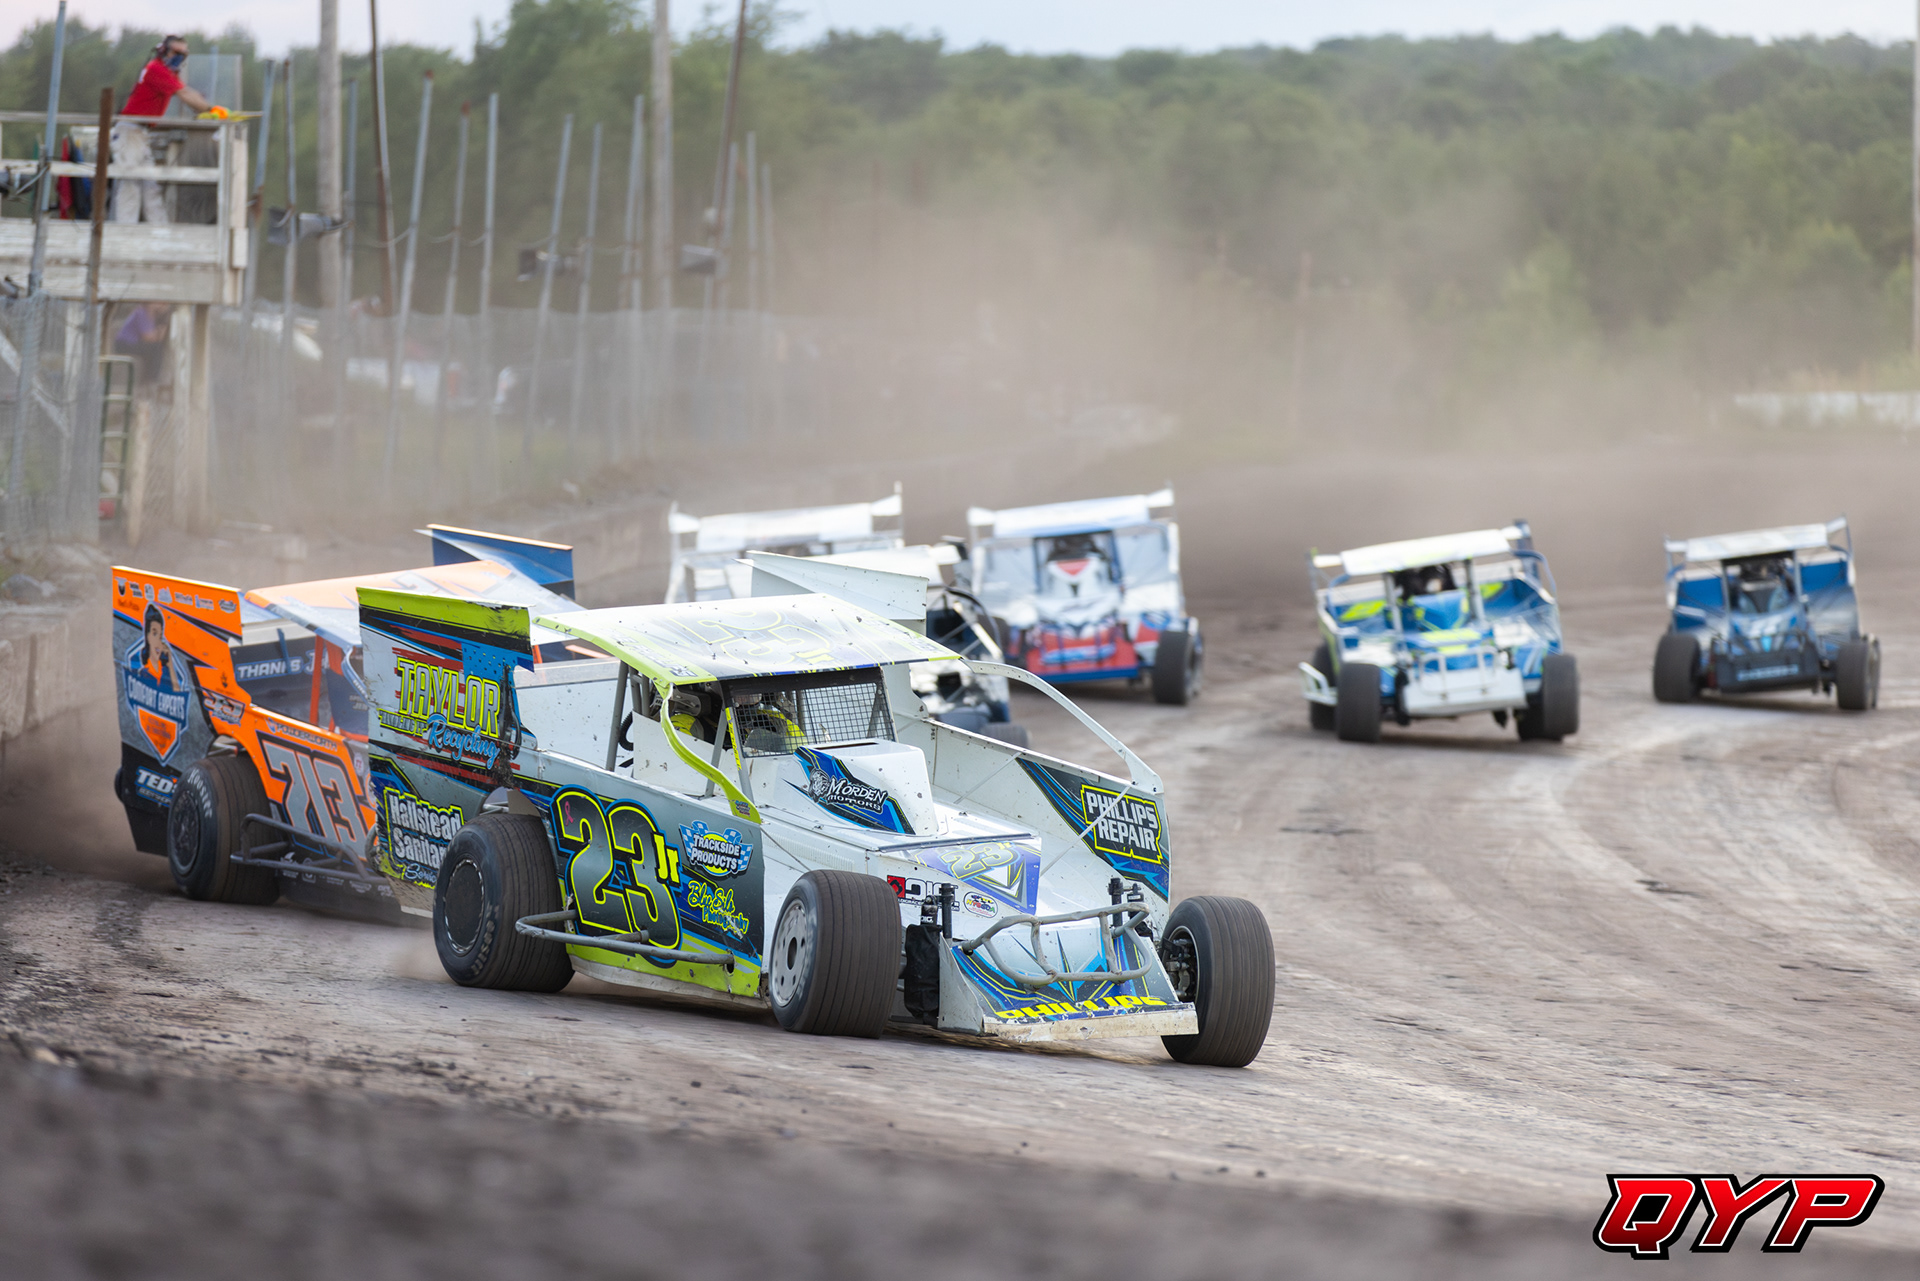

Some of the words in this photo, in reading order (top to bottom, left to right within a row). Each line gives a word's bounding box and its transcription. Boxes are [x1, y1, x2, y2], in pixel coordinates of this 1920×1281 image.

[158, 692, 186, 720] EXPERTS
[398, 658, 500, 737] TAYLOR
[427, 714, 500, 769] Recycling
[828, 777, 887, 803] MORDEN
[389, 795, 461, 840] Hallstead
[1085, 791, 1159, 830] PHILLIPS
[393, 827, 448, 870] Sanitar
[693, 834, 740, 857] TRACKSIDE
[1097, 817, 1157, 852] REPAIR
[691, 847, 737, 870] PRODUCTS
